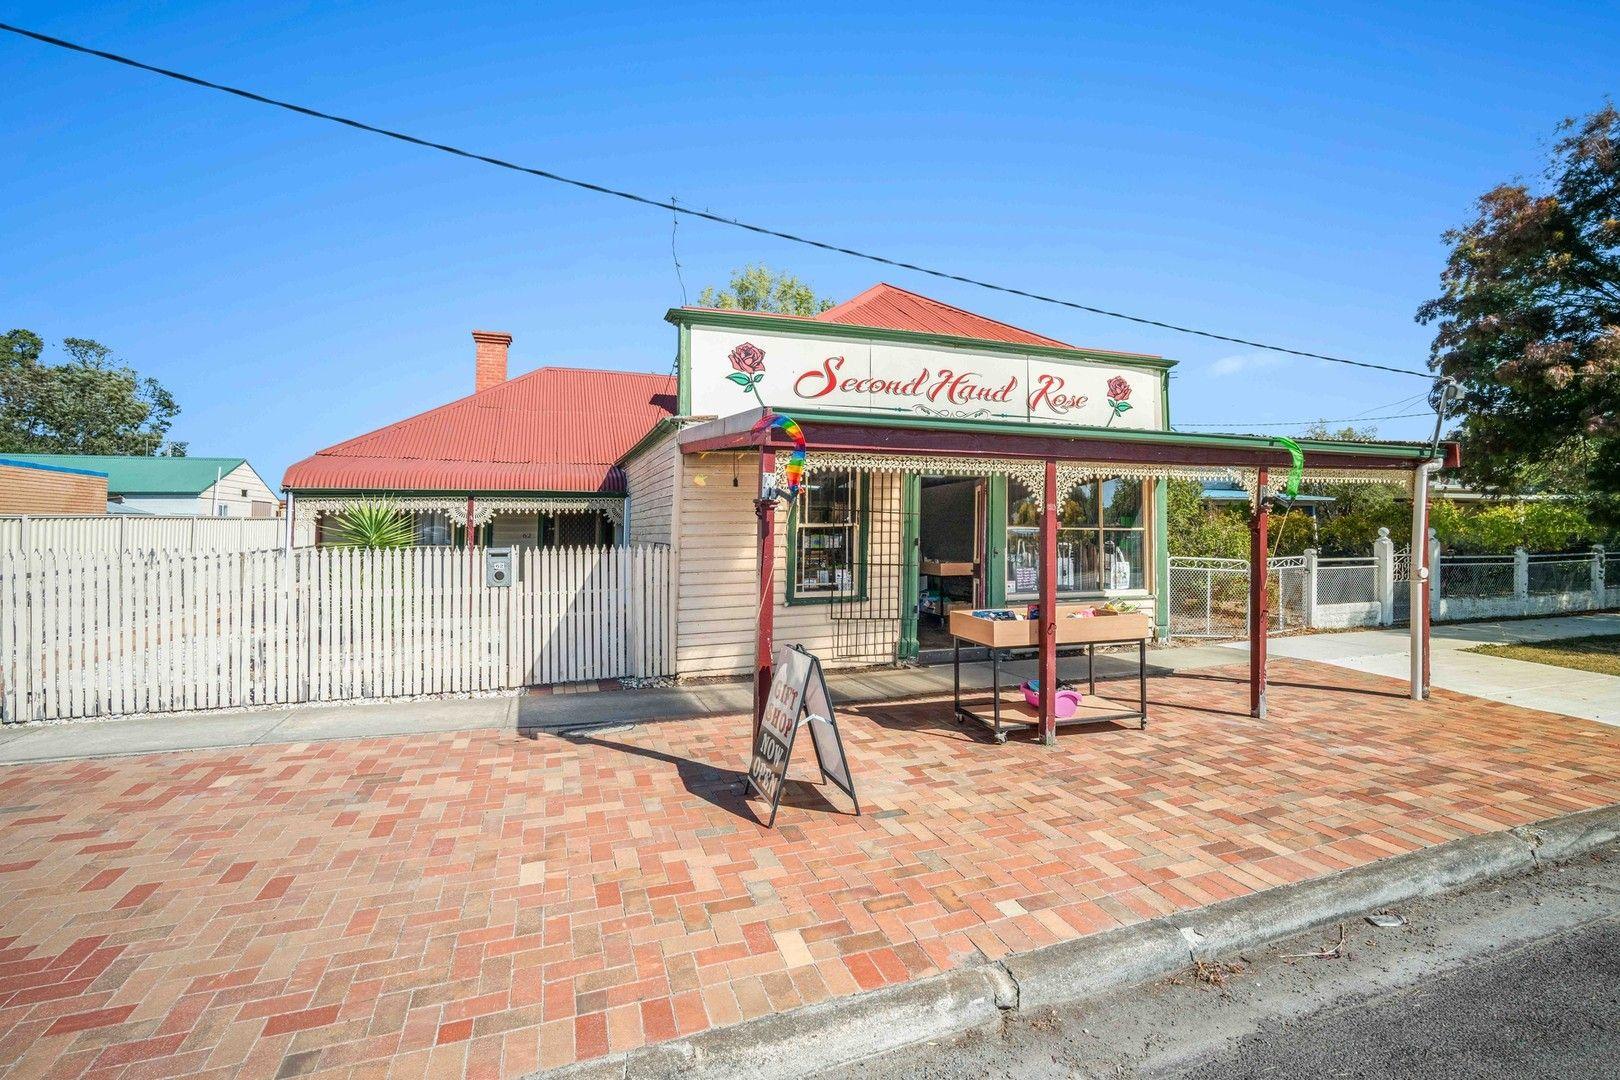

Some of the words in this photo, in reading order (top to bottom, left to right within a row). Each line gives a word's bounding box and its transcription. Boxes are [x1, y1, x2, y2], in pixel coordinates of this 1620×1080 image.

[793, 356, 929, 399] Second
[926, 369, 1018, 405] Hand
[1026, 374, 1089, 415] Rose
[775, 680, 798, 710] GIFT
[766, 703, 792, 738] SHOP
[760, 733, 784, 767] NOW
[752, 757, 778, 798] OPEN
